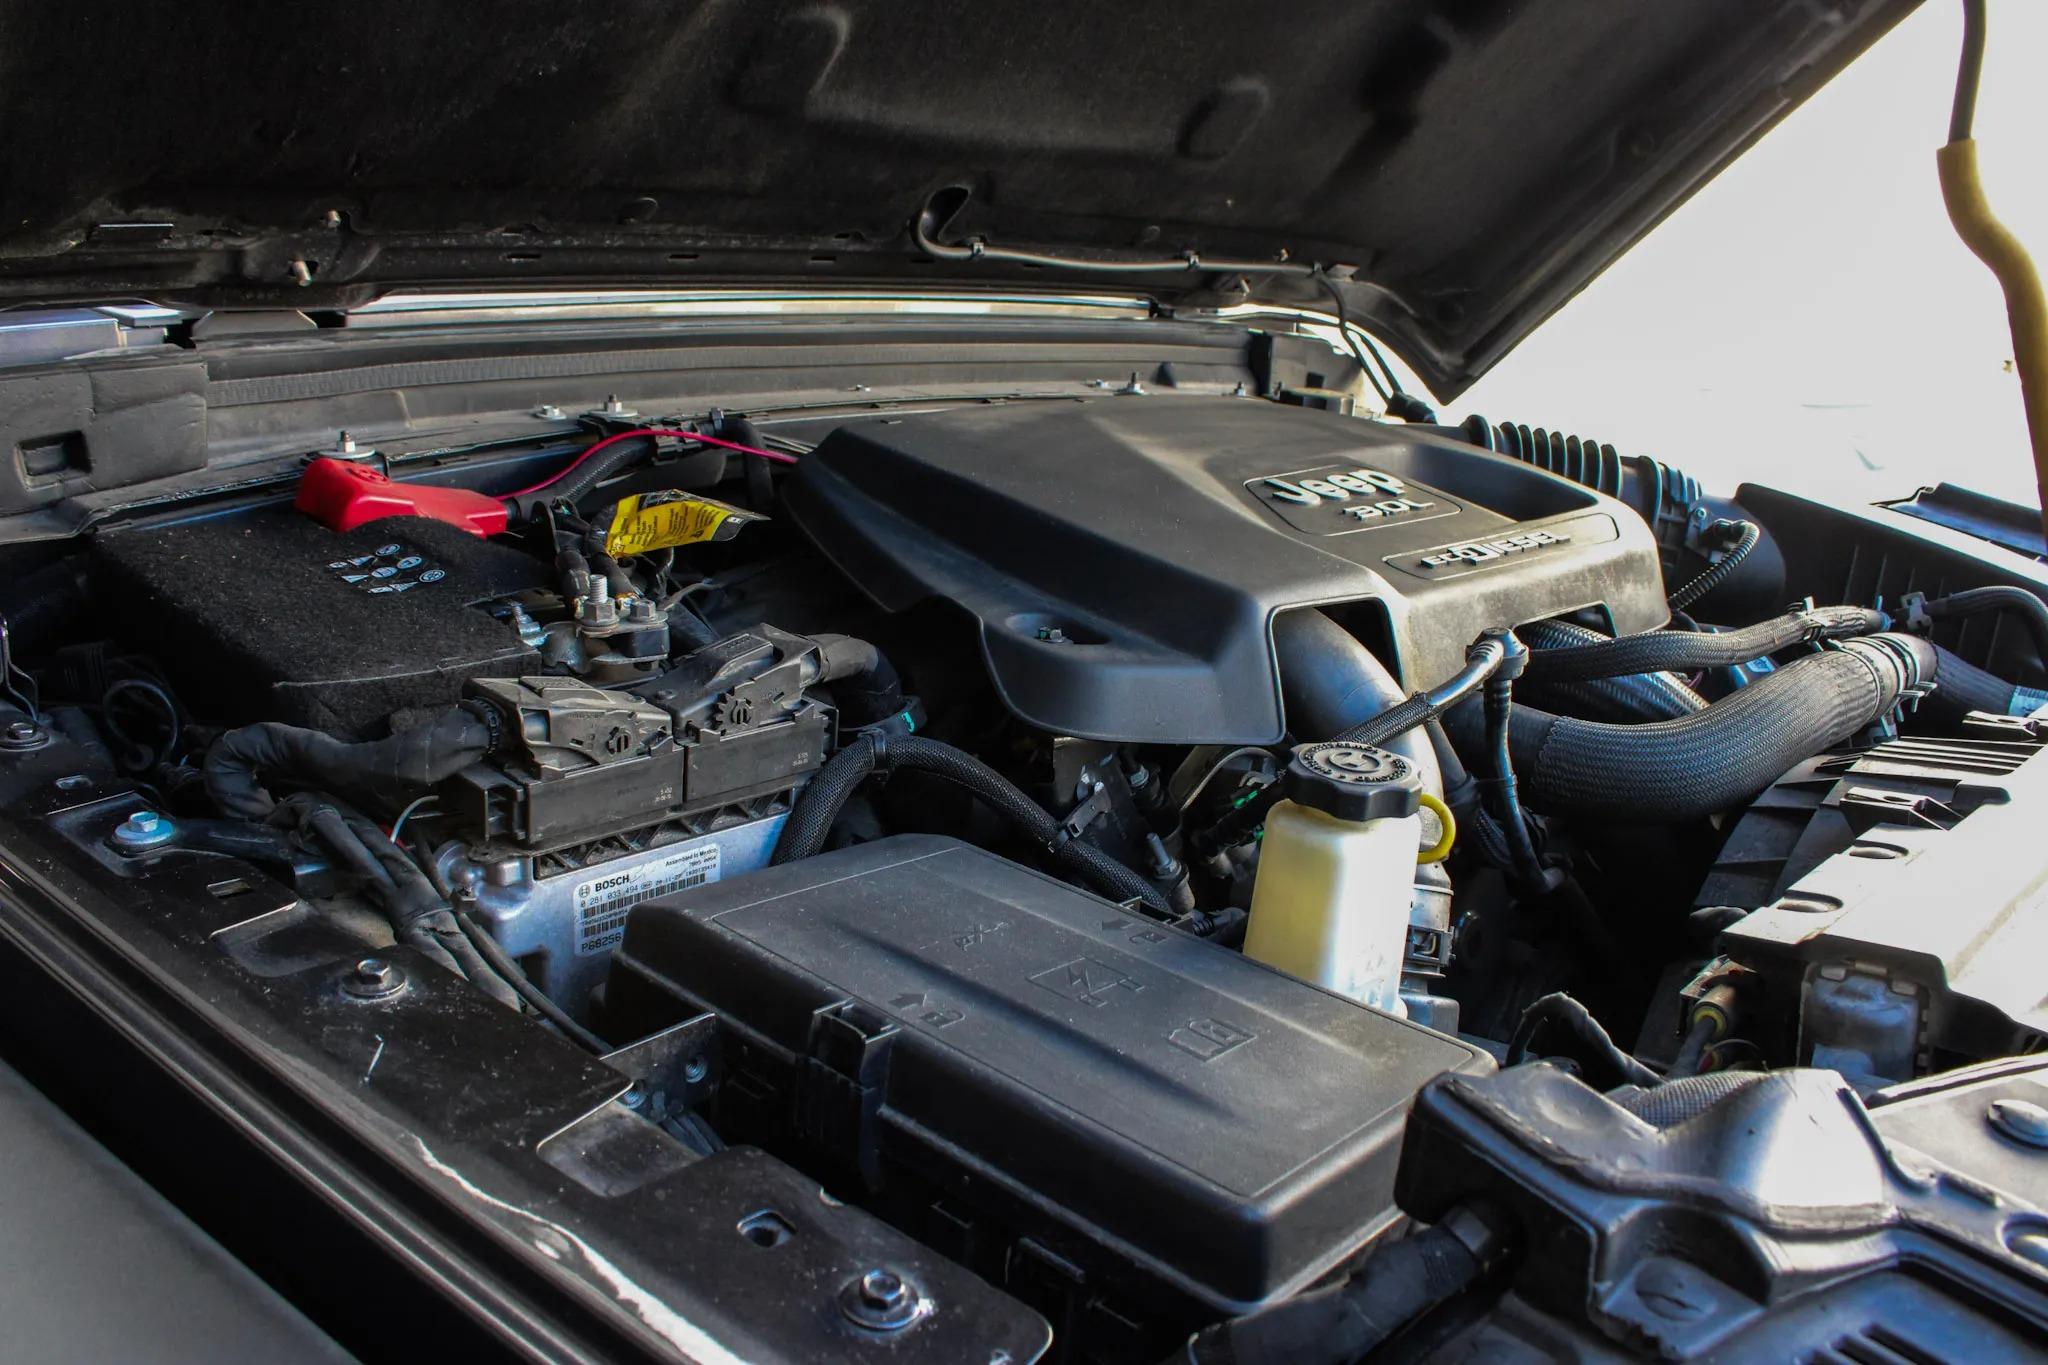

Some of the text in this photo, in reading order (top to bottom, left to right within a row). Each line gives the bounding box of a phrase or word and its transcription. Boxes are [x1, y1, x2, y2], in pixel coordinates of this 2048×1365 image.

[1263, 468, 1406, 506] Jeep
[595, 874, 630, 892] BOSCH
[590, 893, 603, 905] 281
[607, 889, 621, 900] 033
[625, 885, 639, 896] 494
